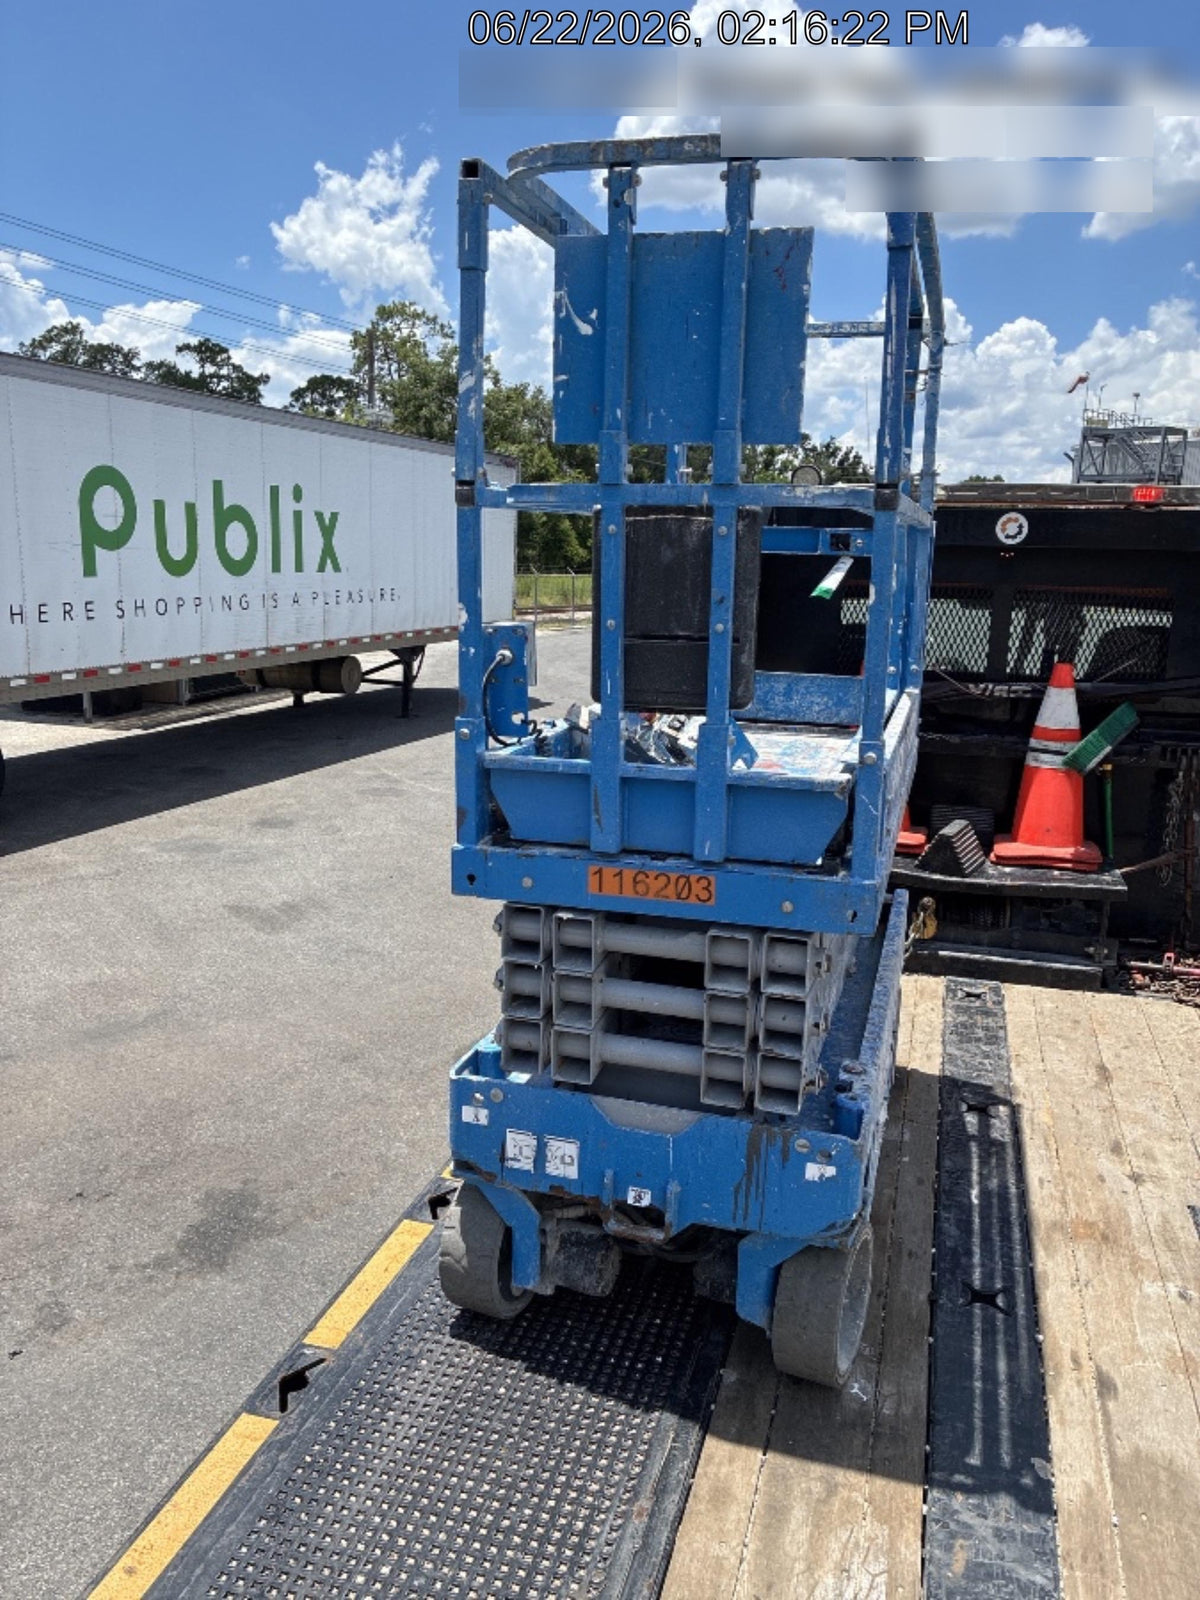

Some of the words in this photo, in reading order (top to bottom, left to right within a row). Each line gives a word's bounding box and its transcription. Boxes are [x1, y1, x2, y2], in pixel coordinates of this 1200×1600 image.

[78, 464, 342, 578] Publix
[115, 593, 250, 620] SHOPPING
[262, 591, 279, 609] IS
[291, 591, 301, 607] A
[591, 866, 714, 903] 116203
